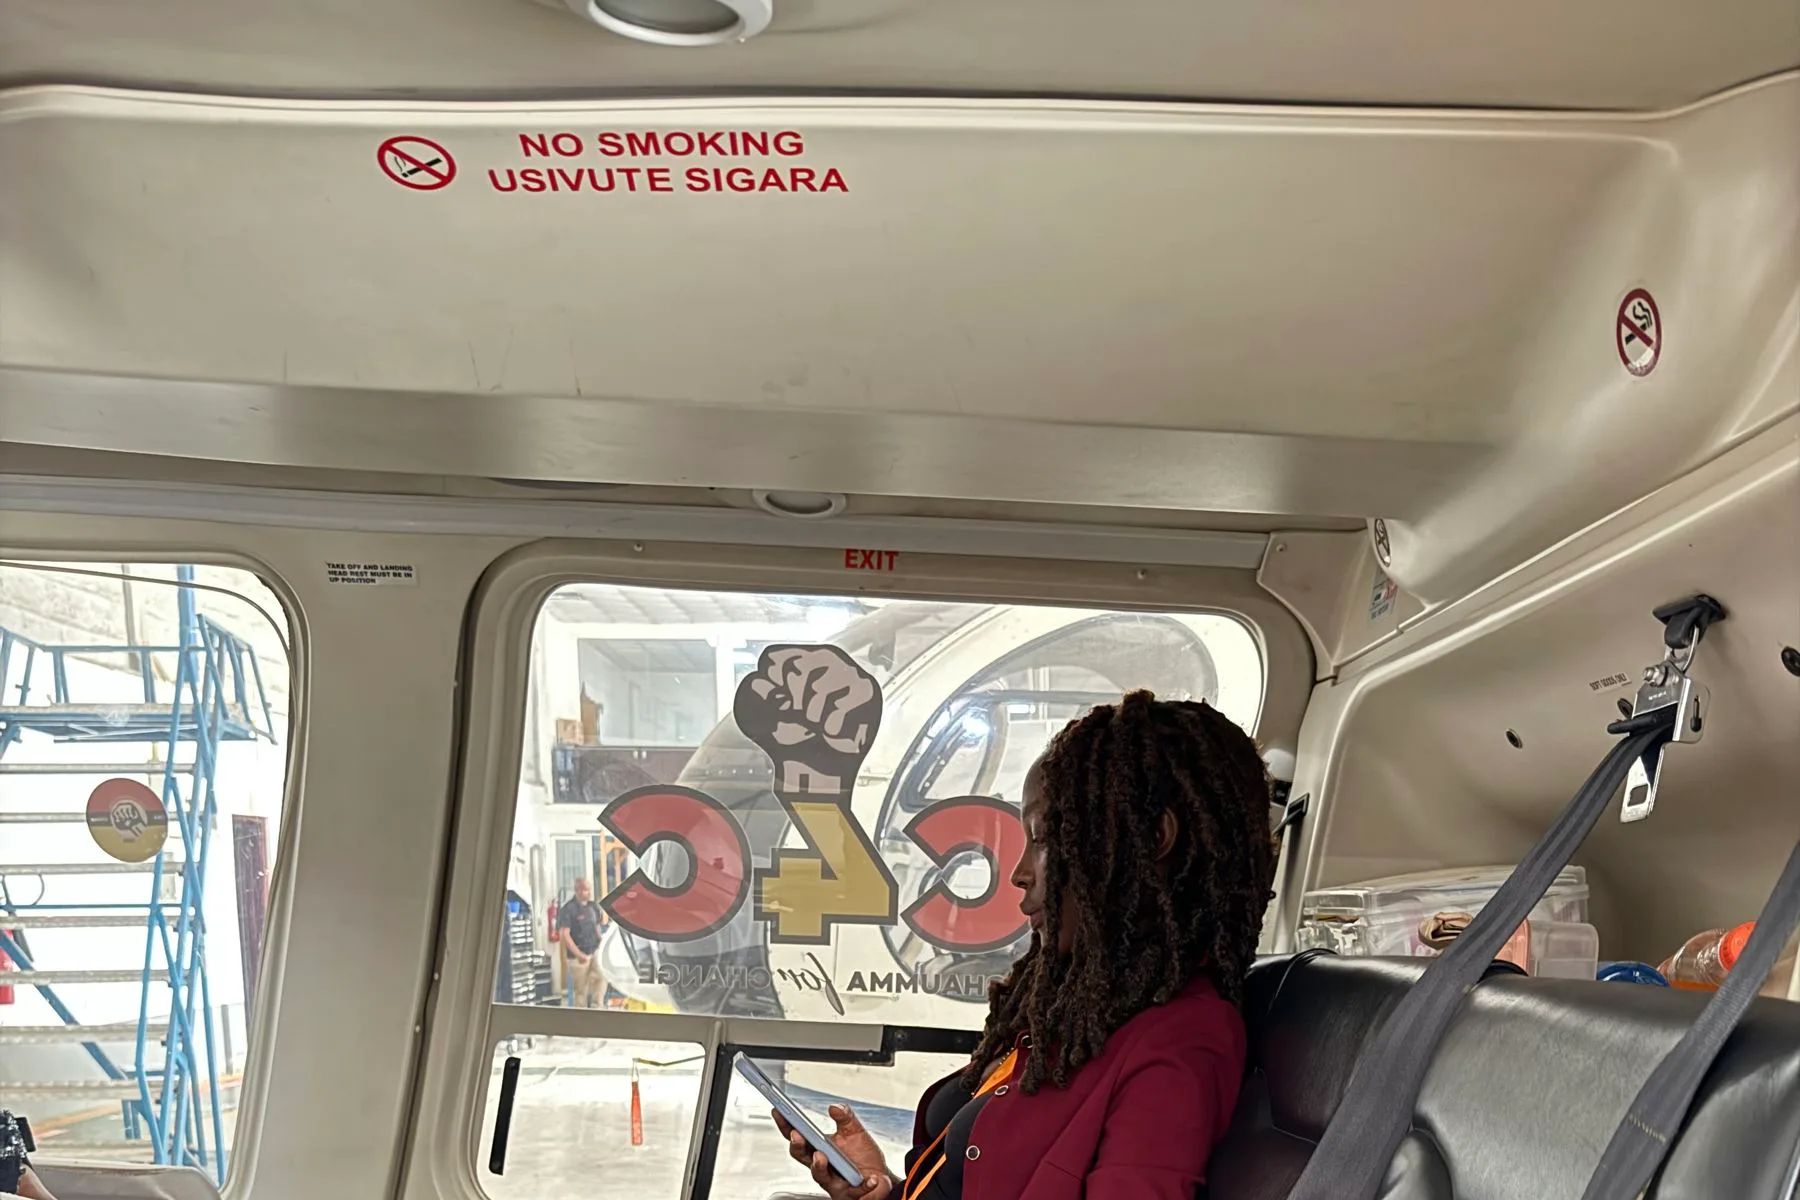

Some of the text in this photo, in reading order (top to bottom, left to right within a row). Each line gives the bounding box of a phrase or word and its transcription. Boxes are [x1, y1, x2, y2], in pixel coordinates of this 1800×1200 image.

[518, 131, 804, 157] NO SMOKING
[488, 167, 849, 192] USIVUTE SIGARA
[844, 548, 899, 571] EXIT
